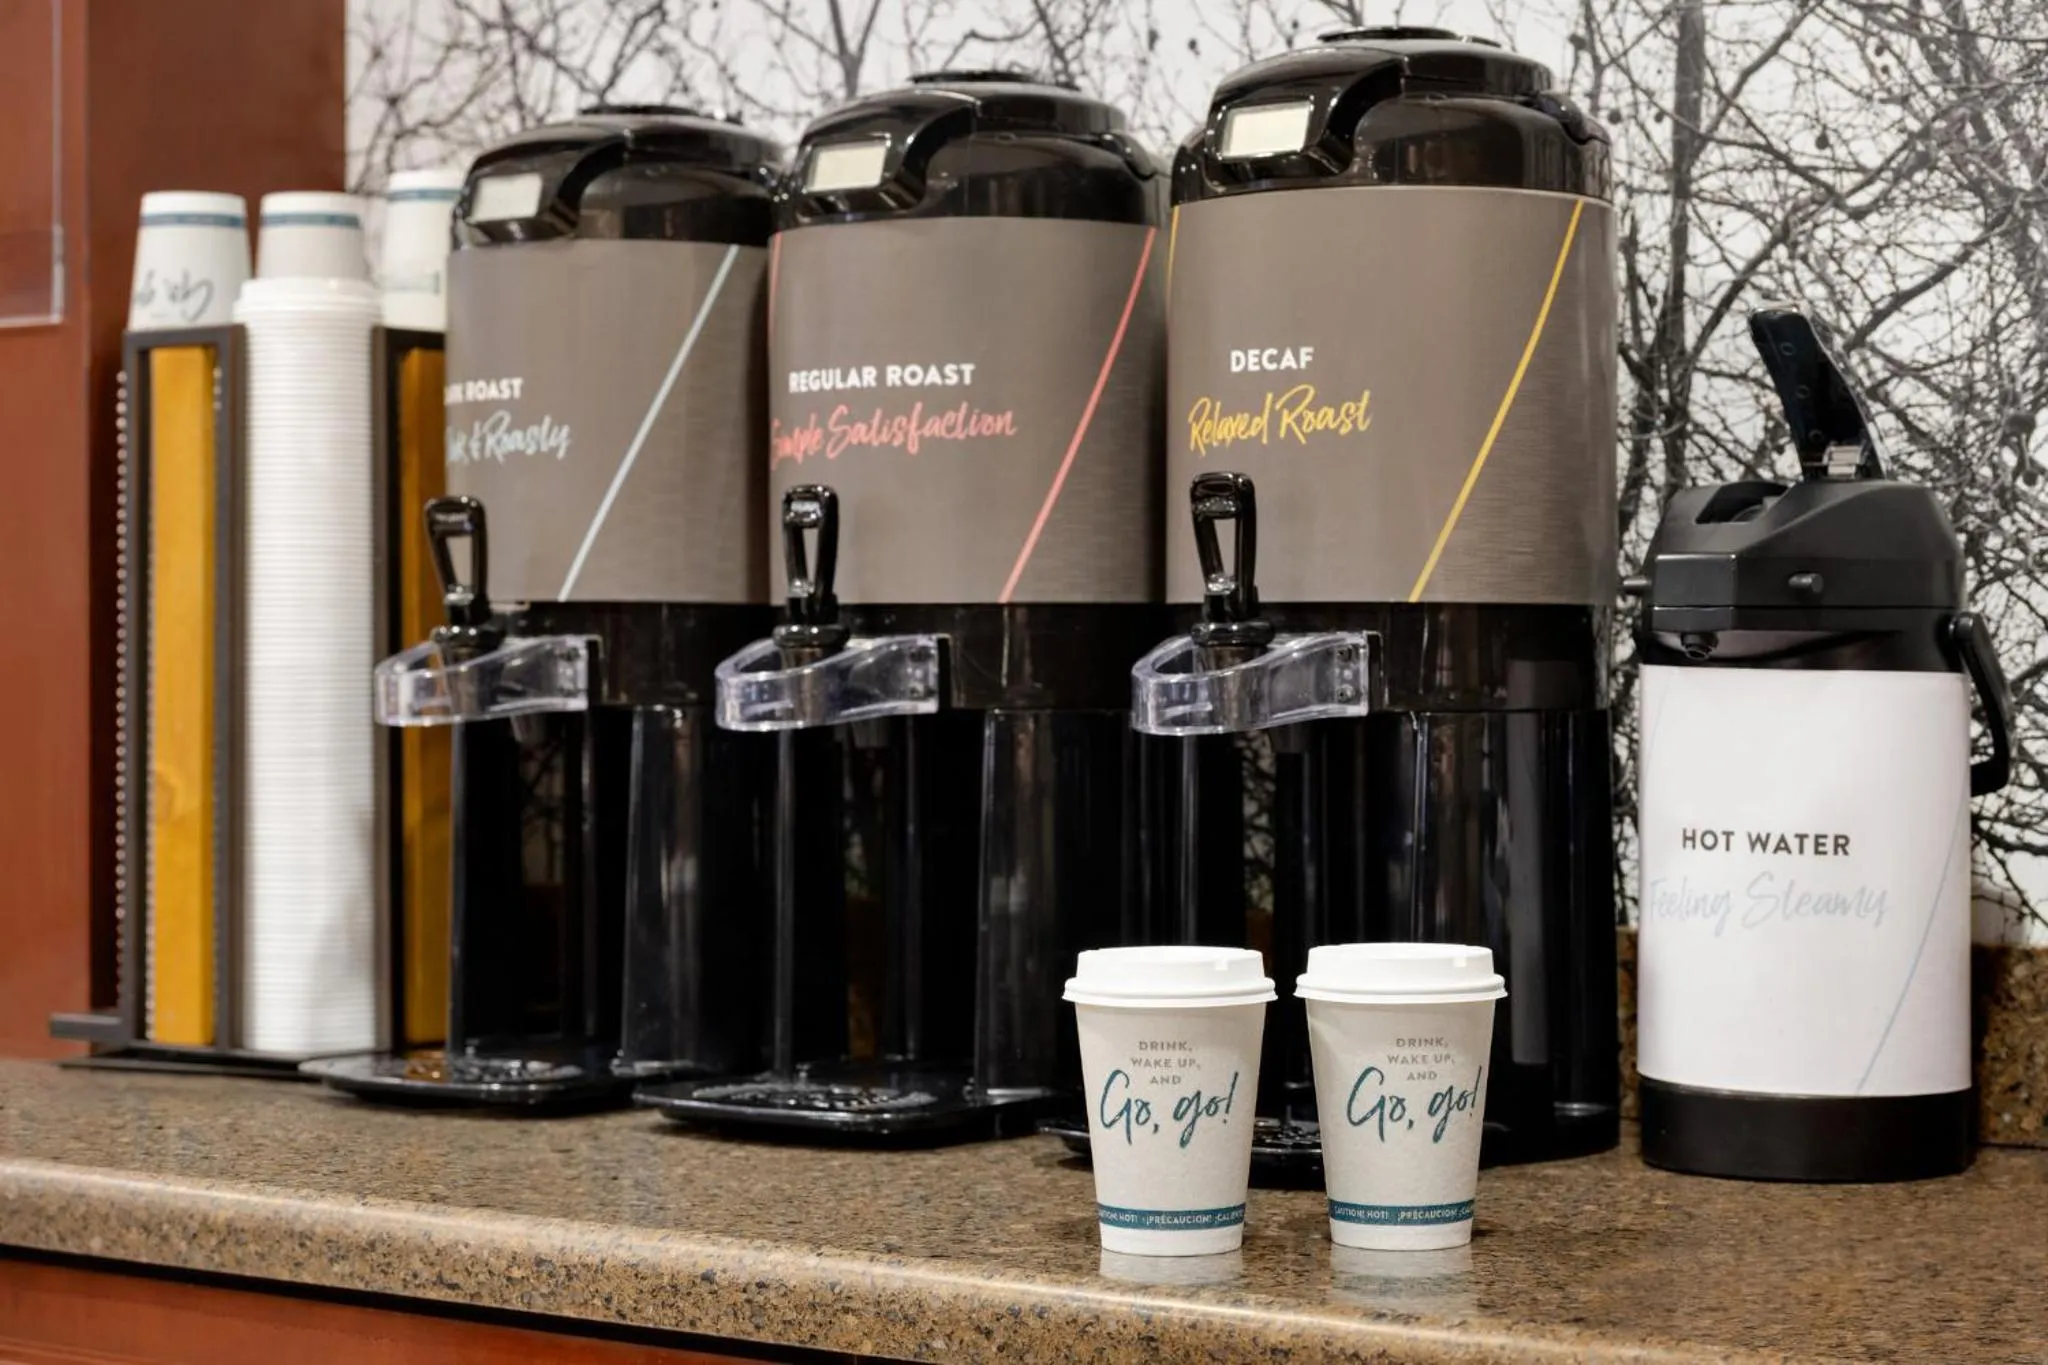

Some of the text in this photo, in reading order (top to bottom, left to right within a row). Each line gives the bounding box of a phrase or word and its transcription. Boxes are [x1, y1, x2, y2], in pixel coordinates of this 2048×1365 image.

[1230, 346, 1314, 372] DECAF
[465, 376, 524, 402] ROAST
[788, 362, 976, 393] REGULAR ROAST
[825, 400, 1018, 460] Satisfaction
[1187, 383, 1374, 457] Relaxed Roast
[1682, 828, 1851, 856] HOT WATER
[1649, 870, 1890, 938] Feeling Steamy
[1138, 1040, 1193, 1052] DRINK,
[1395, 1037, 1449, 1048] DRINK,
[1130, 1058, 1202, 1070] WAKE UP,
[1387, 1053, 1456, 1065] WAKE UP,
[1150, 1075, 1182, 1086] AND
[1407, 1071, 1438, 1081] AND
[1100, 1069, 1239, 1149] Go, go!
[1346, 1065, 1482, 1144] Go, go!
